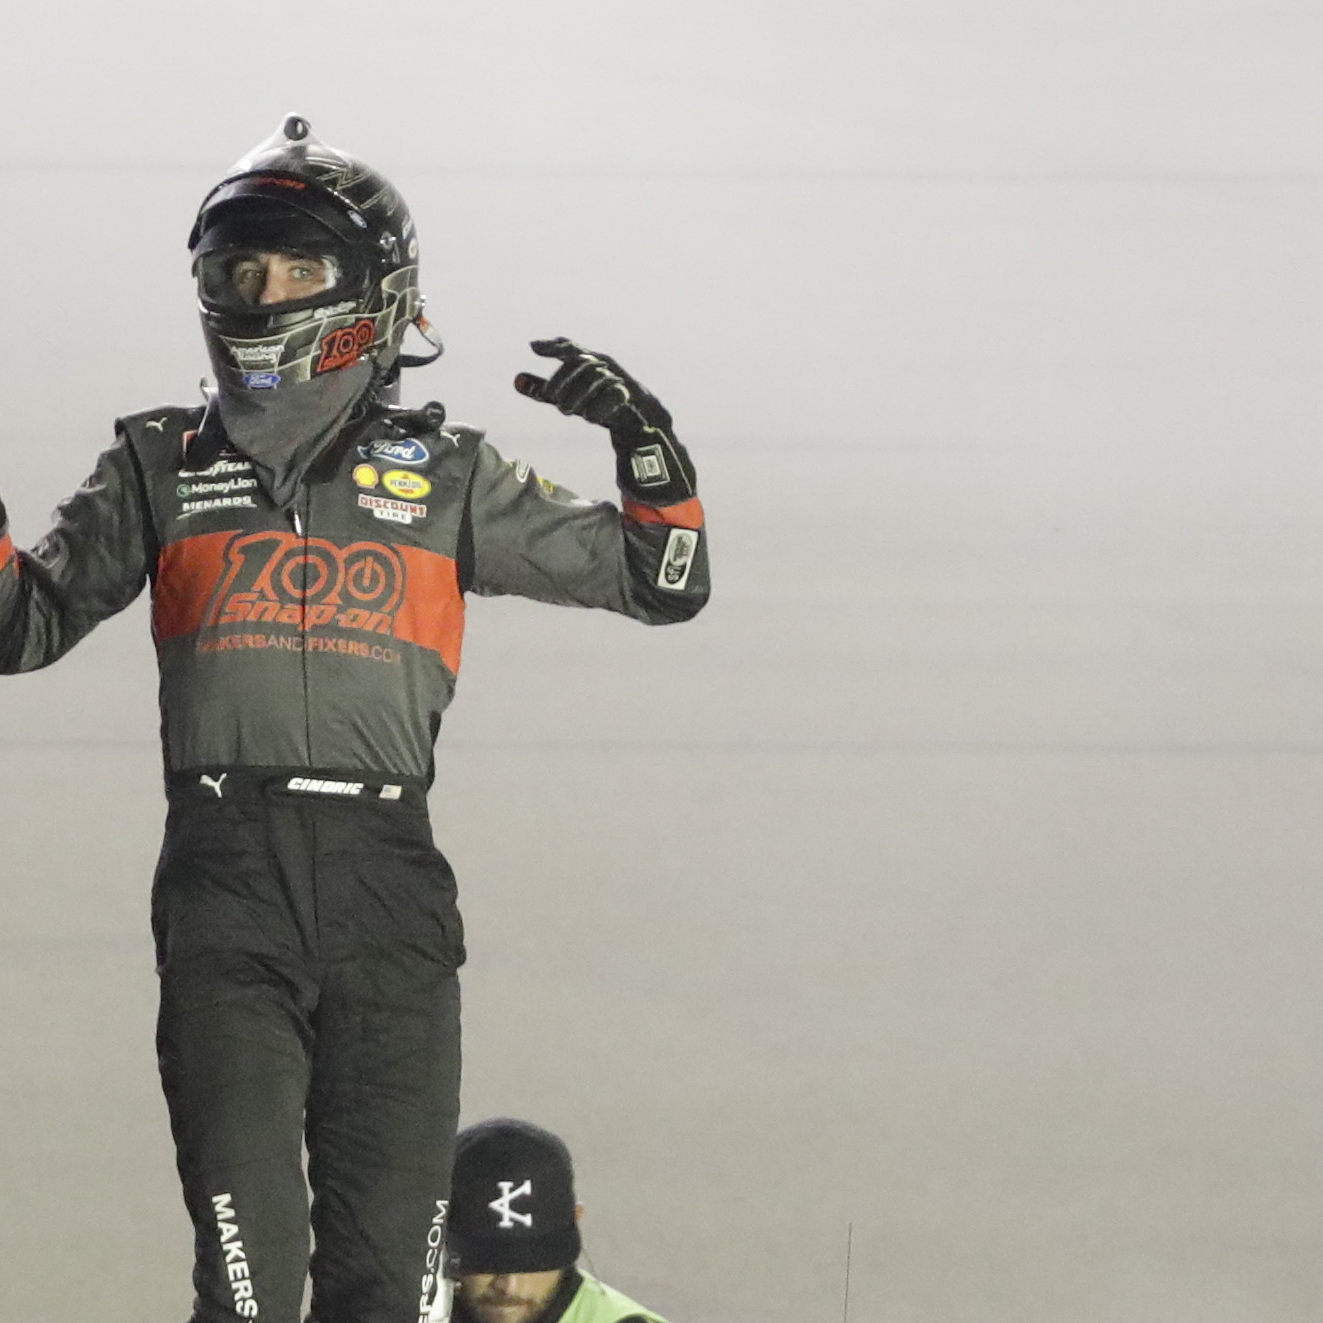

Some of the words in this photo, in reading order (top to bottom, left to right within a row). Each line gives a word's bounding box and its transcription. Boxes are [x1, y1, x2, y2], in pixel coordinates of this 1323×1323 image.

[370, 440, 417, 460] Ford
[190, 478, 258, 494] MoneyLion
[182, 495, 252, 512] MENARDS
[359, 496, 426, 517] DISCOUNT
[378, 509, 408, 521] TIRE
[287, 777, 365, 795] CINDRIC
